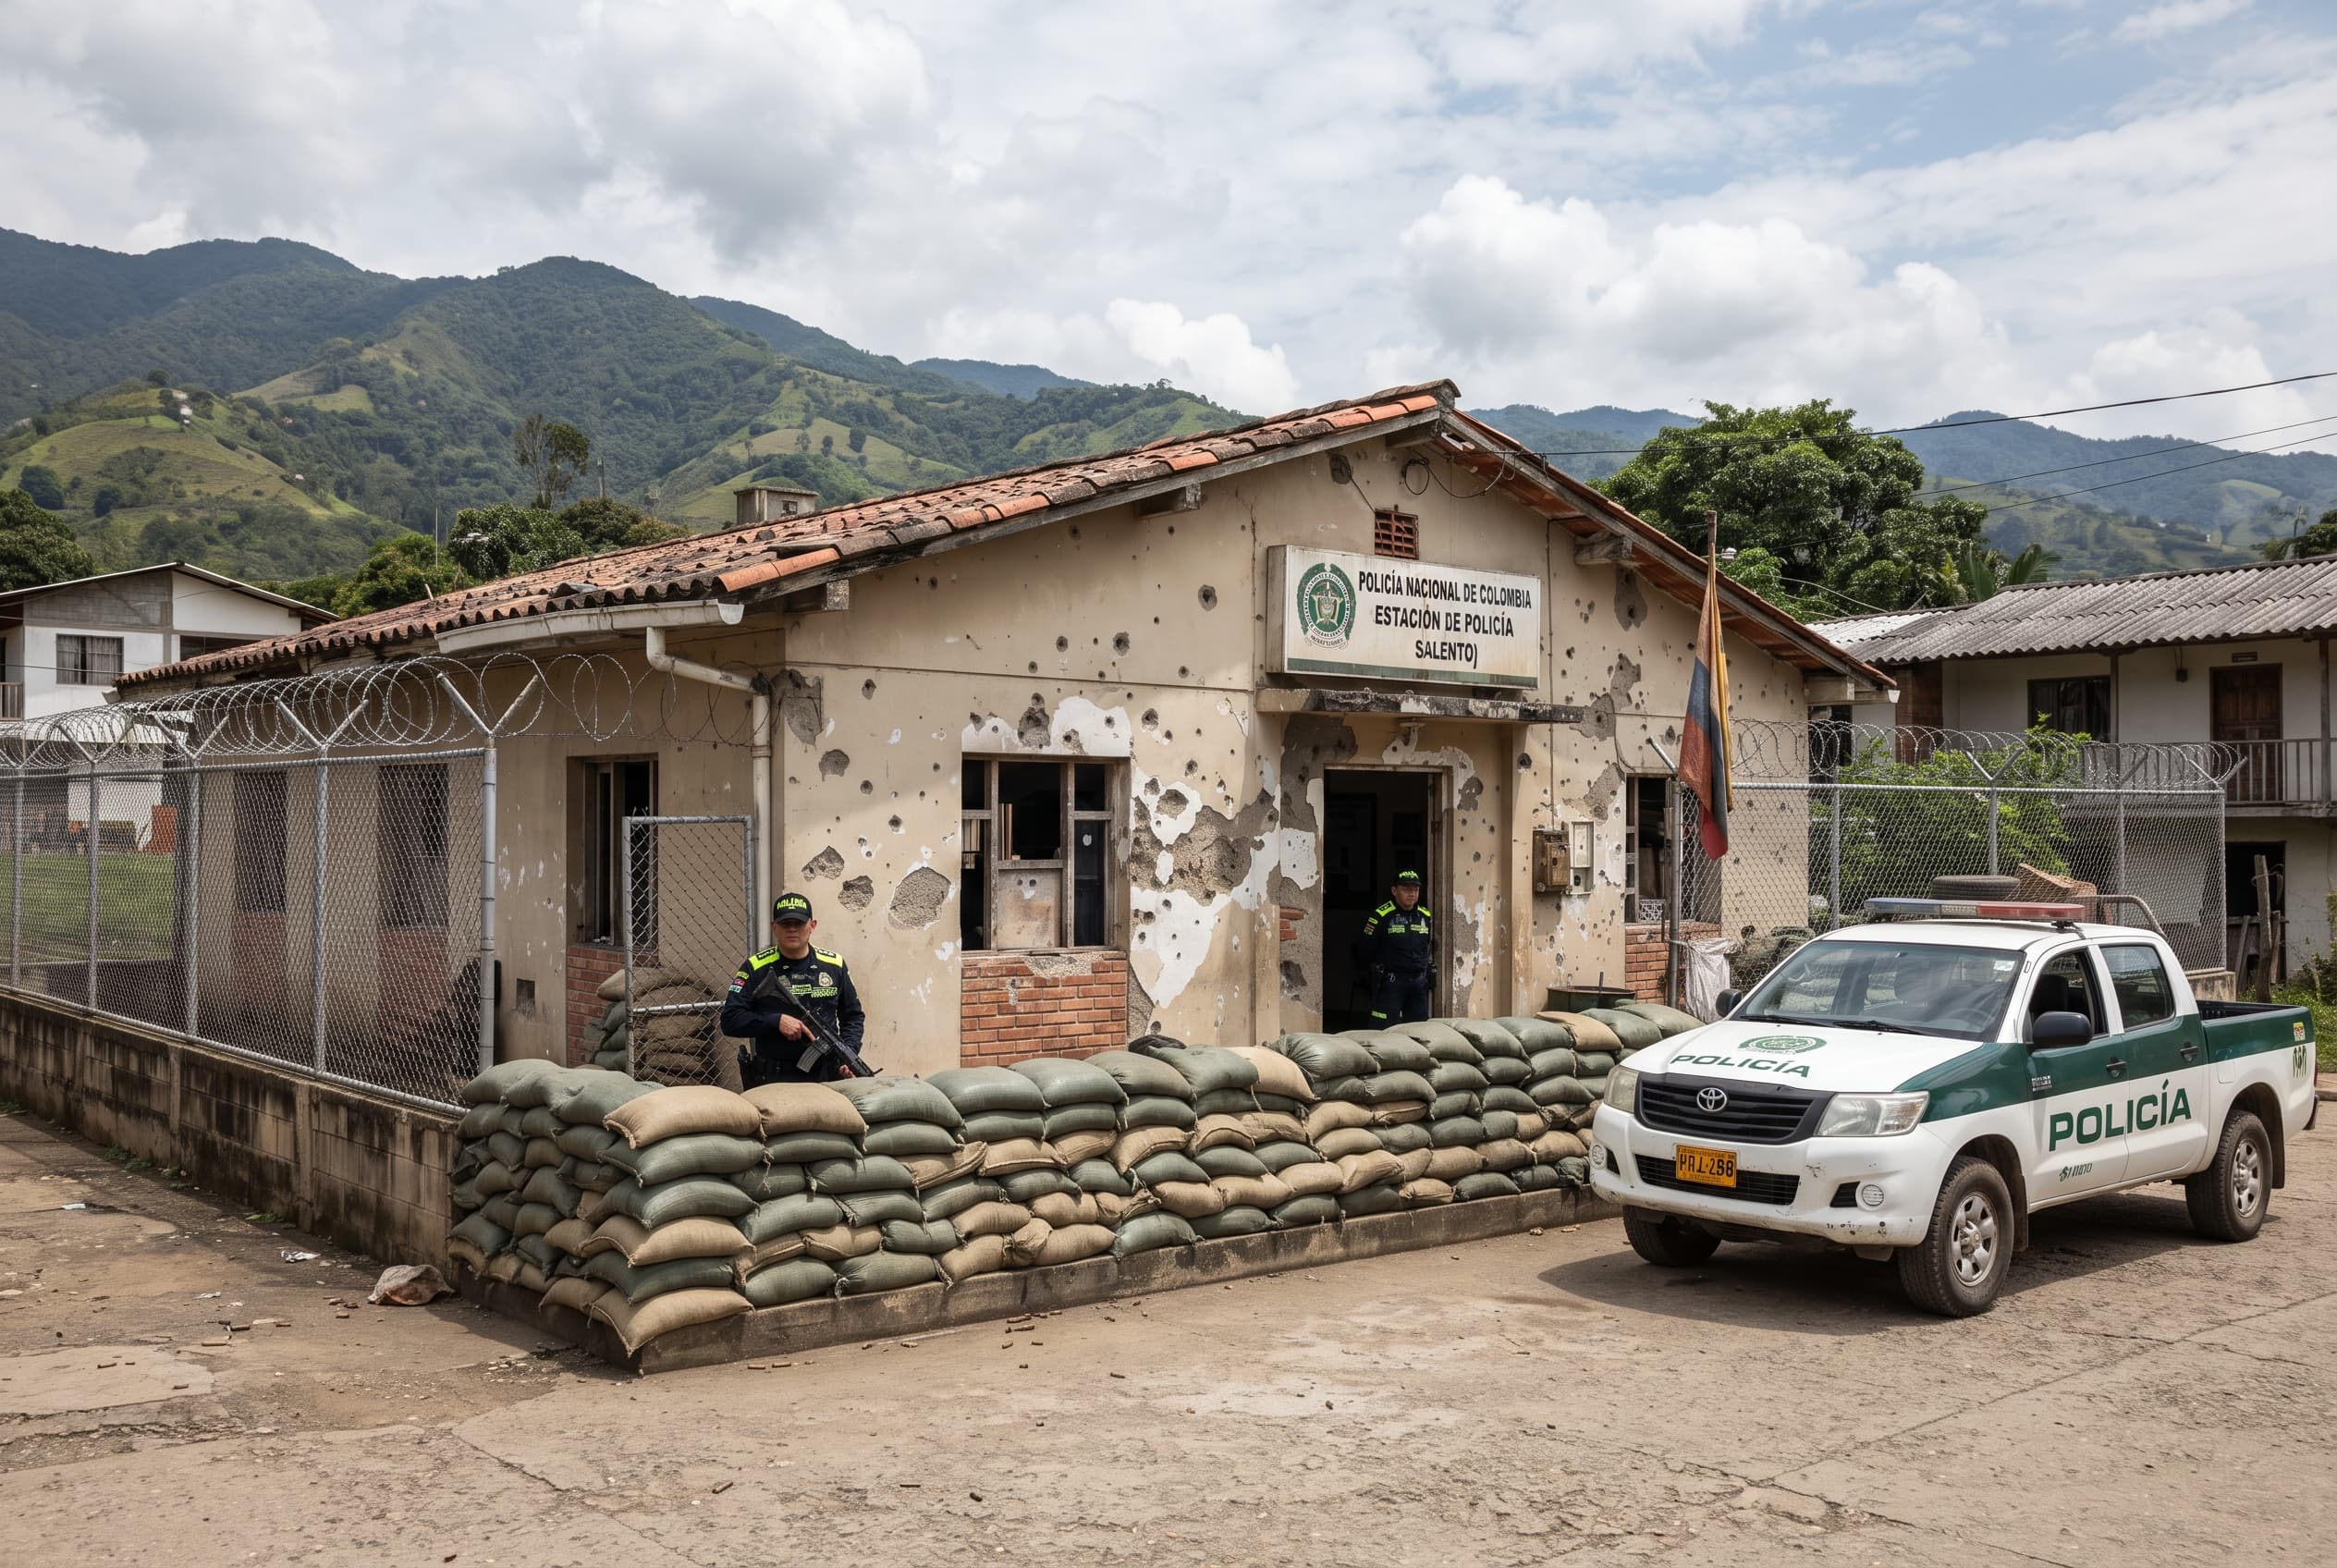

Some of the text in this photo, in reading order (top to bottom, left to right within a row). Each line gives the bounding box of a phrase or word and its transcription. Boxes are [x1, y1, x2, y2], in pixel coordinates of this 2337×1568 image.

[1359, 570, 1532, 609] POLICÍA NACIONAL DE COLOMBIA
[1375, 604, 1514, 637] ESTACIÓN DE POLICÍA
[1415, 640, 1478, 669] SALENTO)
[1670, 1055, 1810, 1078] POLICÍA
[2049, 1078, 2192, 1152] POLICÍA
